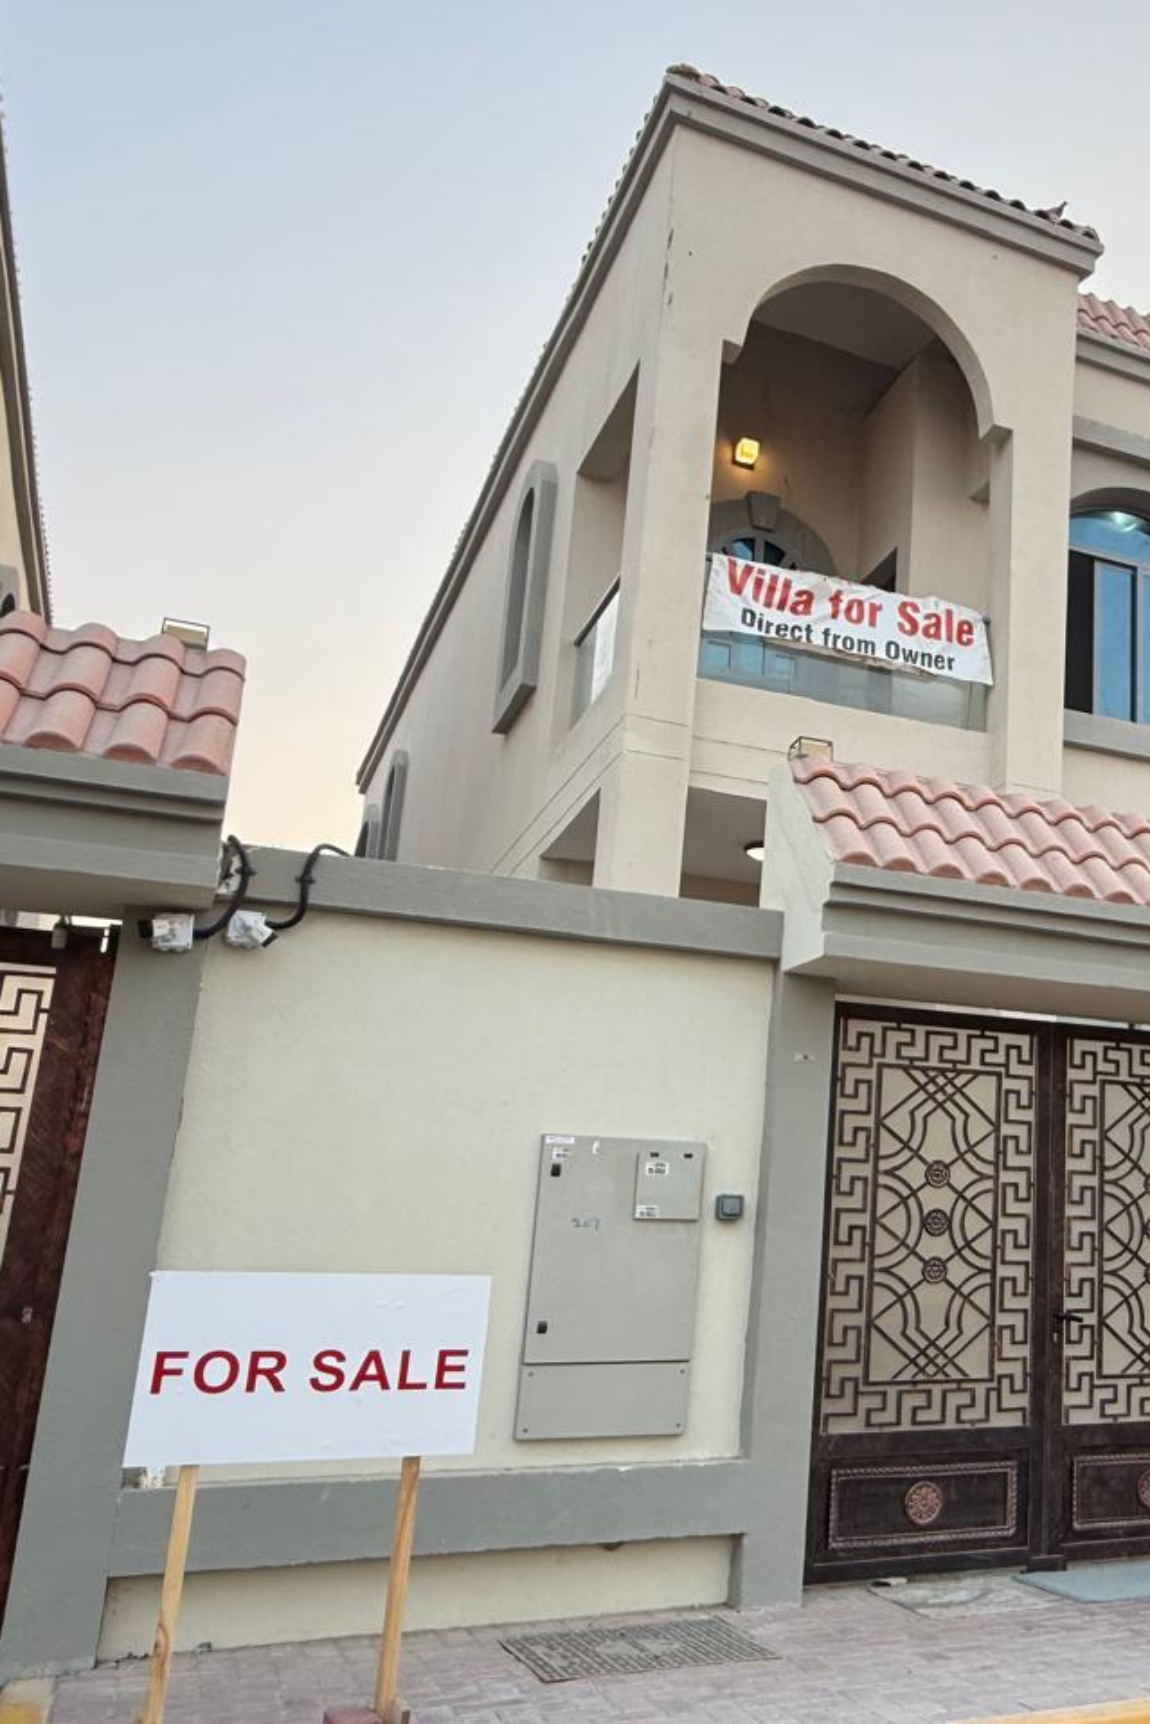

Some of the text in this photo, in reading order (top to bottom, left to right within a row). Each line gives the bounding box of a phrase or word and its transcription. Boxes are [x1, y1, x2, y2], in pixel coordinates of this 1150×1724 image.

[726, 556, 975, 647] Villa for Sale
[741, 608, 955, 671] Direct from Owner
[149, 1349, 471, 1394] FOR SALE
